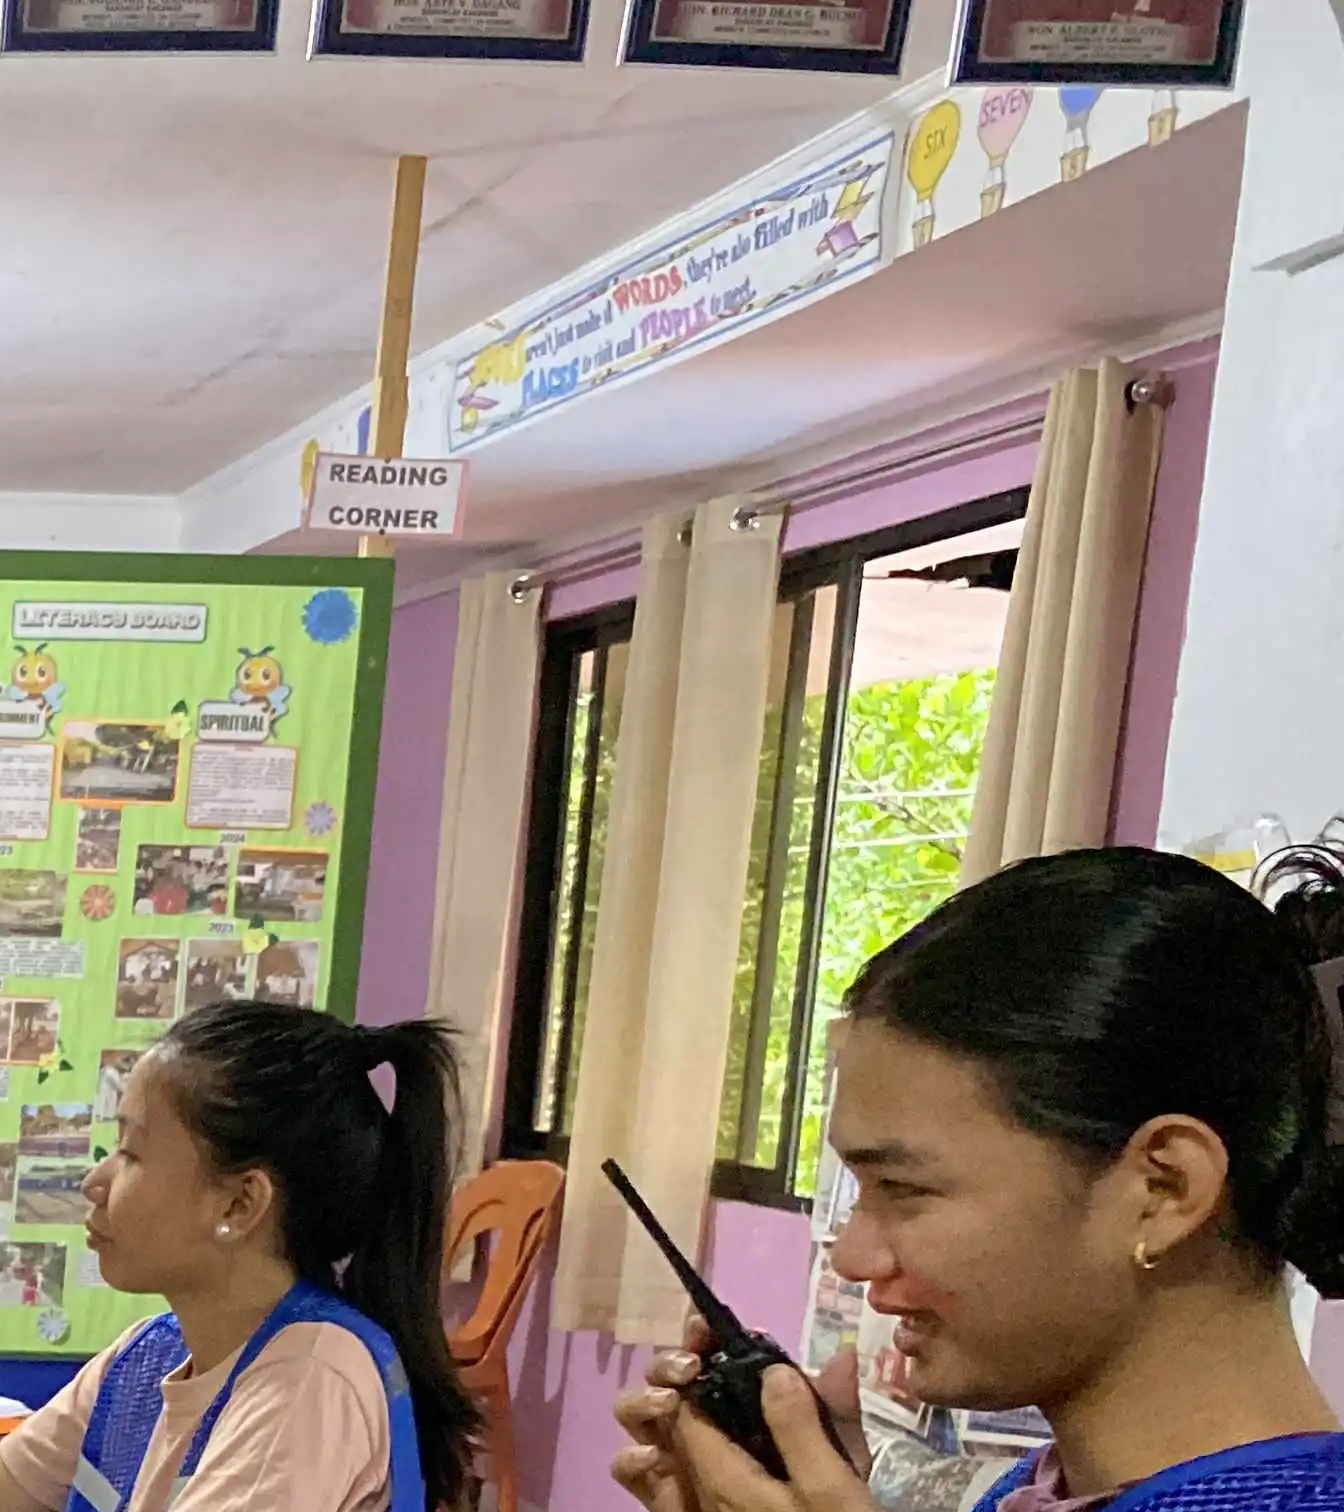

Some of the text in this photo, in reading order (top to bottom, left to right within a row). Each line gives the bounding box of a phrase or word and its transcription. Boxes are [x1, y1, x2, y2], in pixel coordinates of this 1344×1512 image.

[980, 87, 1030, 128] SEVEN
[923, 125, 948, 160] SIX
[754, 206, 795, 250] filled
[798, 192, 829, 231] with
[329, 463, 448, 486] READING
[328, 506, 439, 529] CORNER
[19, 608, 202, 630] LITERACY BOARD
[200, 714, 265, 732] SPIRITUAL
